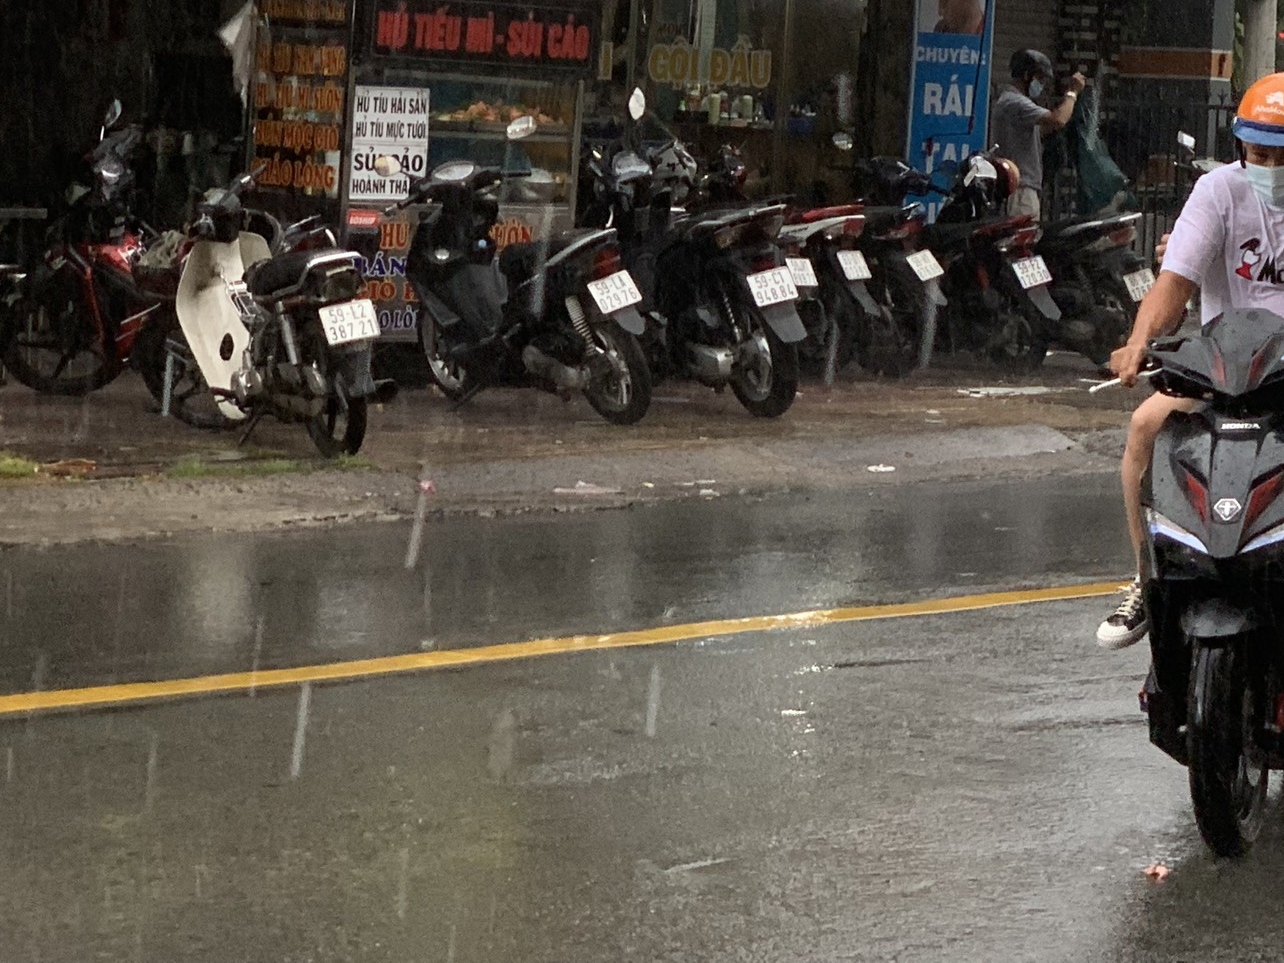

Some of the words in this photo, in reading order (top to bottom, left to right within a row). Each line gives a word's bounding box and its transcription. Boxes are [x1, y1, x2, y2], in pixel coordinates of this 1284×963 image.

[355, 89, 370, 113] HỦ
[373, 92, 389, 114] TÍU
[390, 91, 407, 115] HẢI
[922, 73, 975, 118] RÁI
[355, 115, 368, 138] HỦ
[369, 117, 384, 138] TÍU
[385, 121, 405, 142] MỰC
[353, 146, 383, 172] SỦ
[352, 175, 386, 195] HOÀNH
[328, 303, 368, 324] 59-L2
[1220, 422, 1262, 430] HONDA
